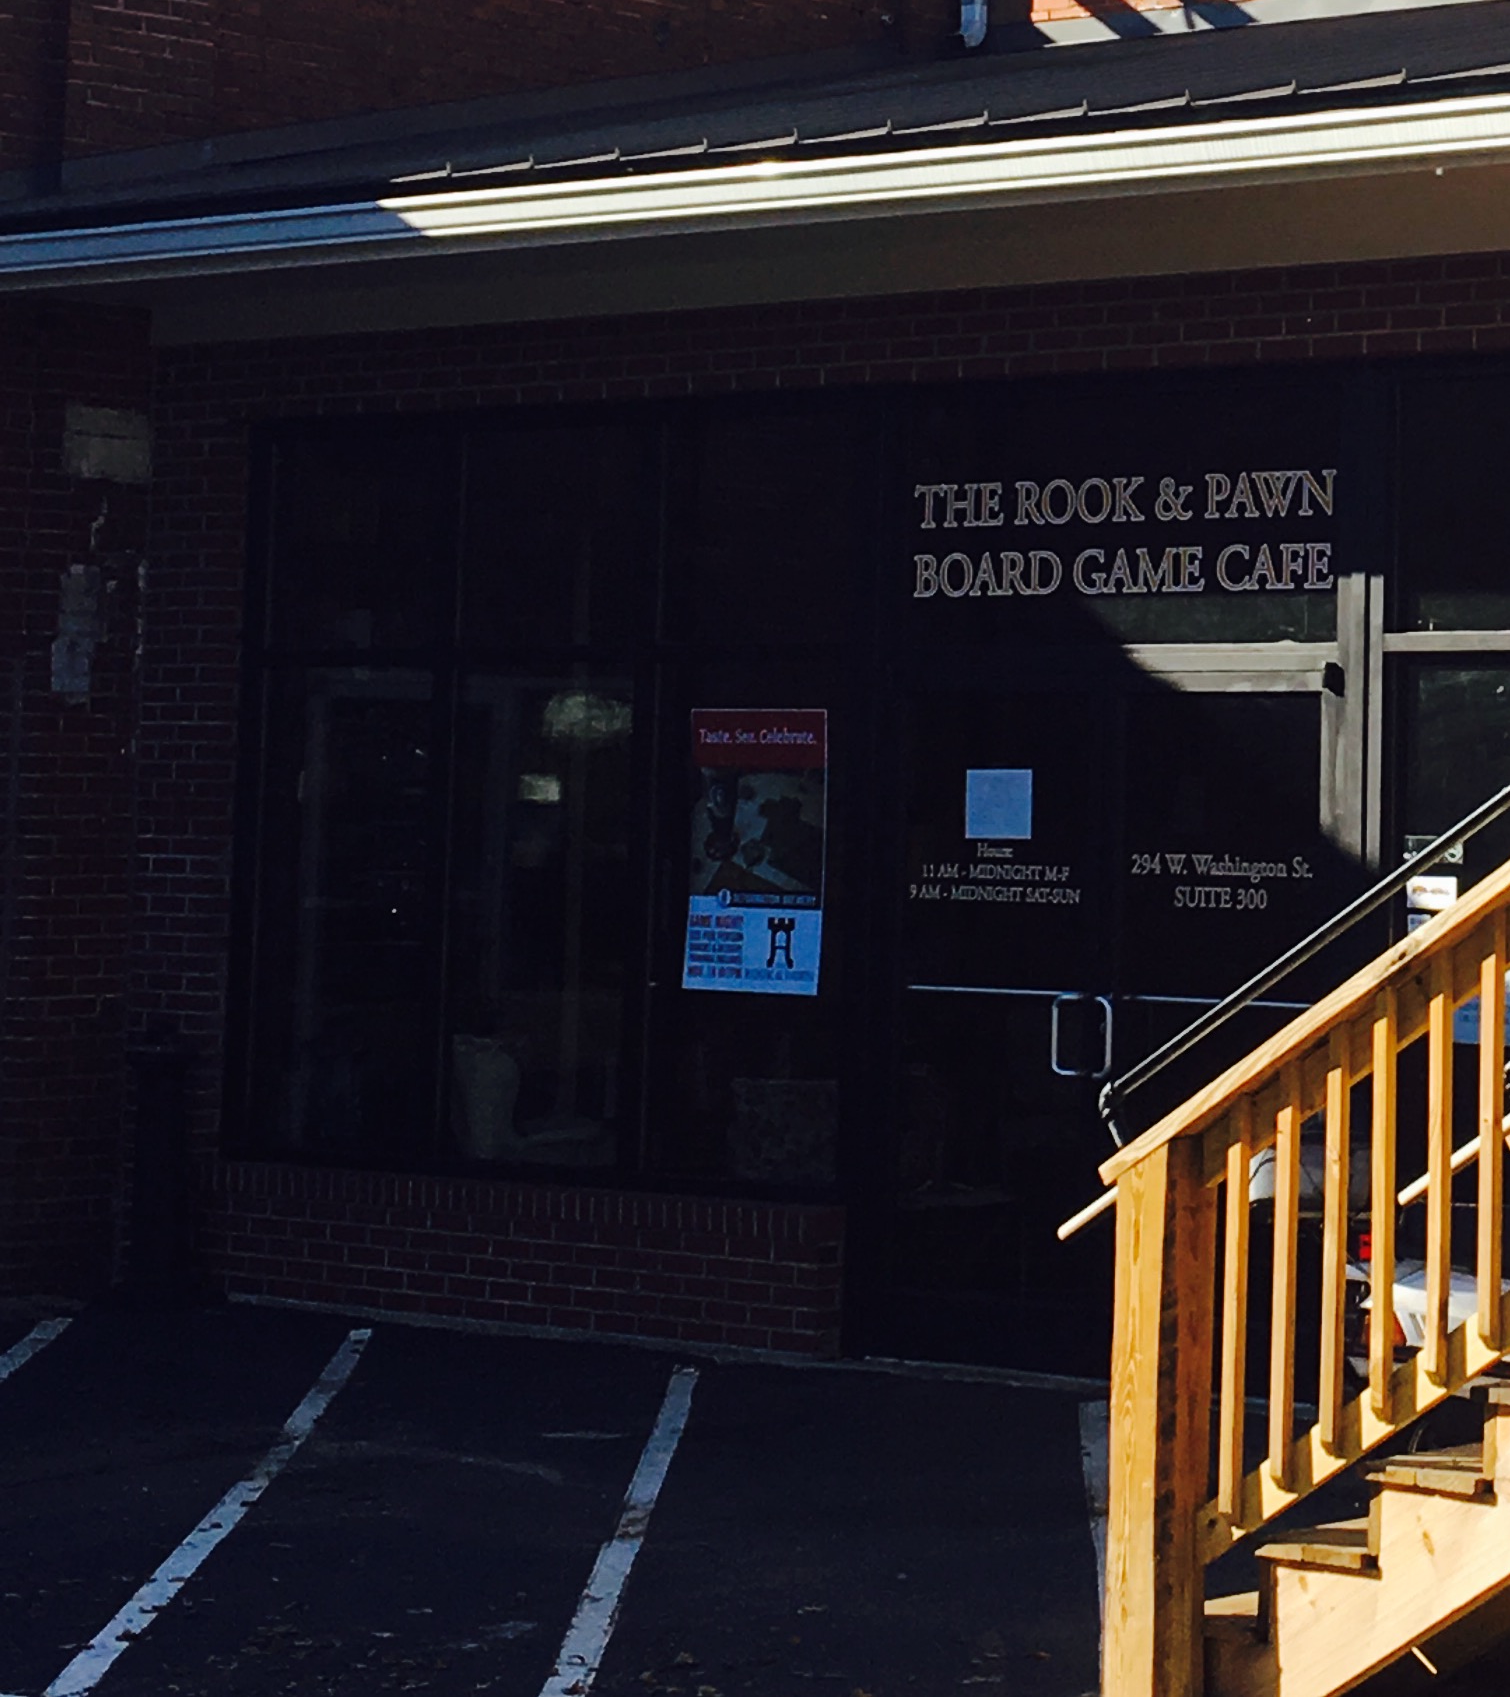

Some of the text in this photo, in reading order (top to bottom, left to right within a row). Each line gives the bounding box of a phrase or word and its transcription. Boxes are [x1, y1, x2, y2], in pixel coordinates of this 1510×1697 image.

[914, 470, 1337, 528] THE ROOK & PAWN
[913, 543, 1334, 597] BOARD GAME CAFE
[923, 864, 934, 878] 11
[937, 864, 959, 878] AM
[969, 864, 1042, 880] MIDNIGHT
[1044, 866, 1070, 881] M-F
[1131, 853, 1313, 883] 294 W. Washington St.
[909, 885, 916, 898] 9
[919, 885, 941, 899] AM
[951, 886, 1024, 901] MIDNIGHT
[1025, 887, 1080, 903] SAT-SUN
[1174, 886, 1268, 910] SUITE 300
